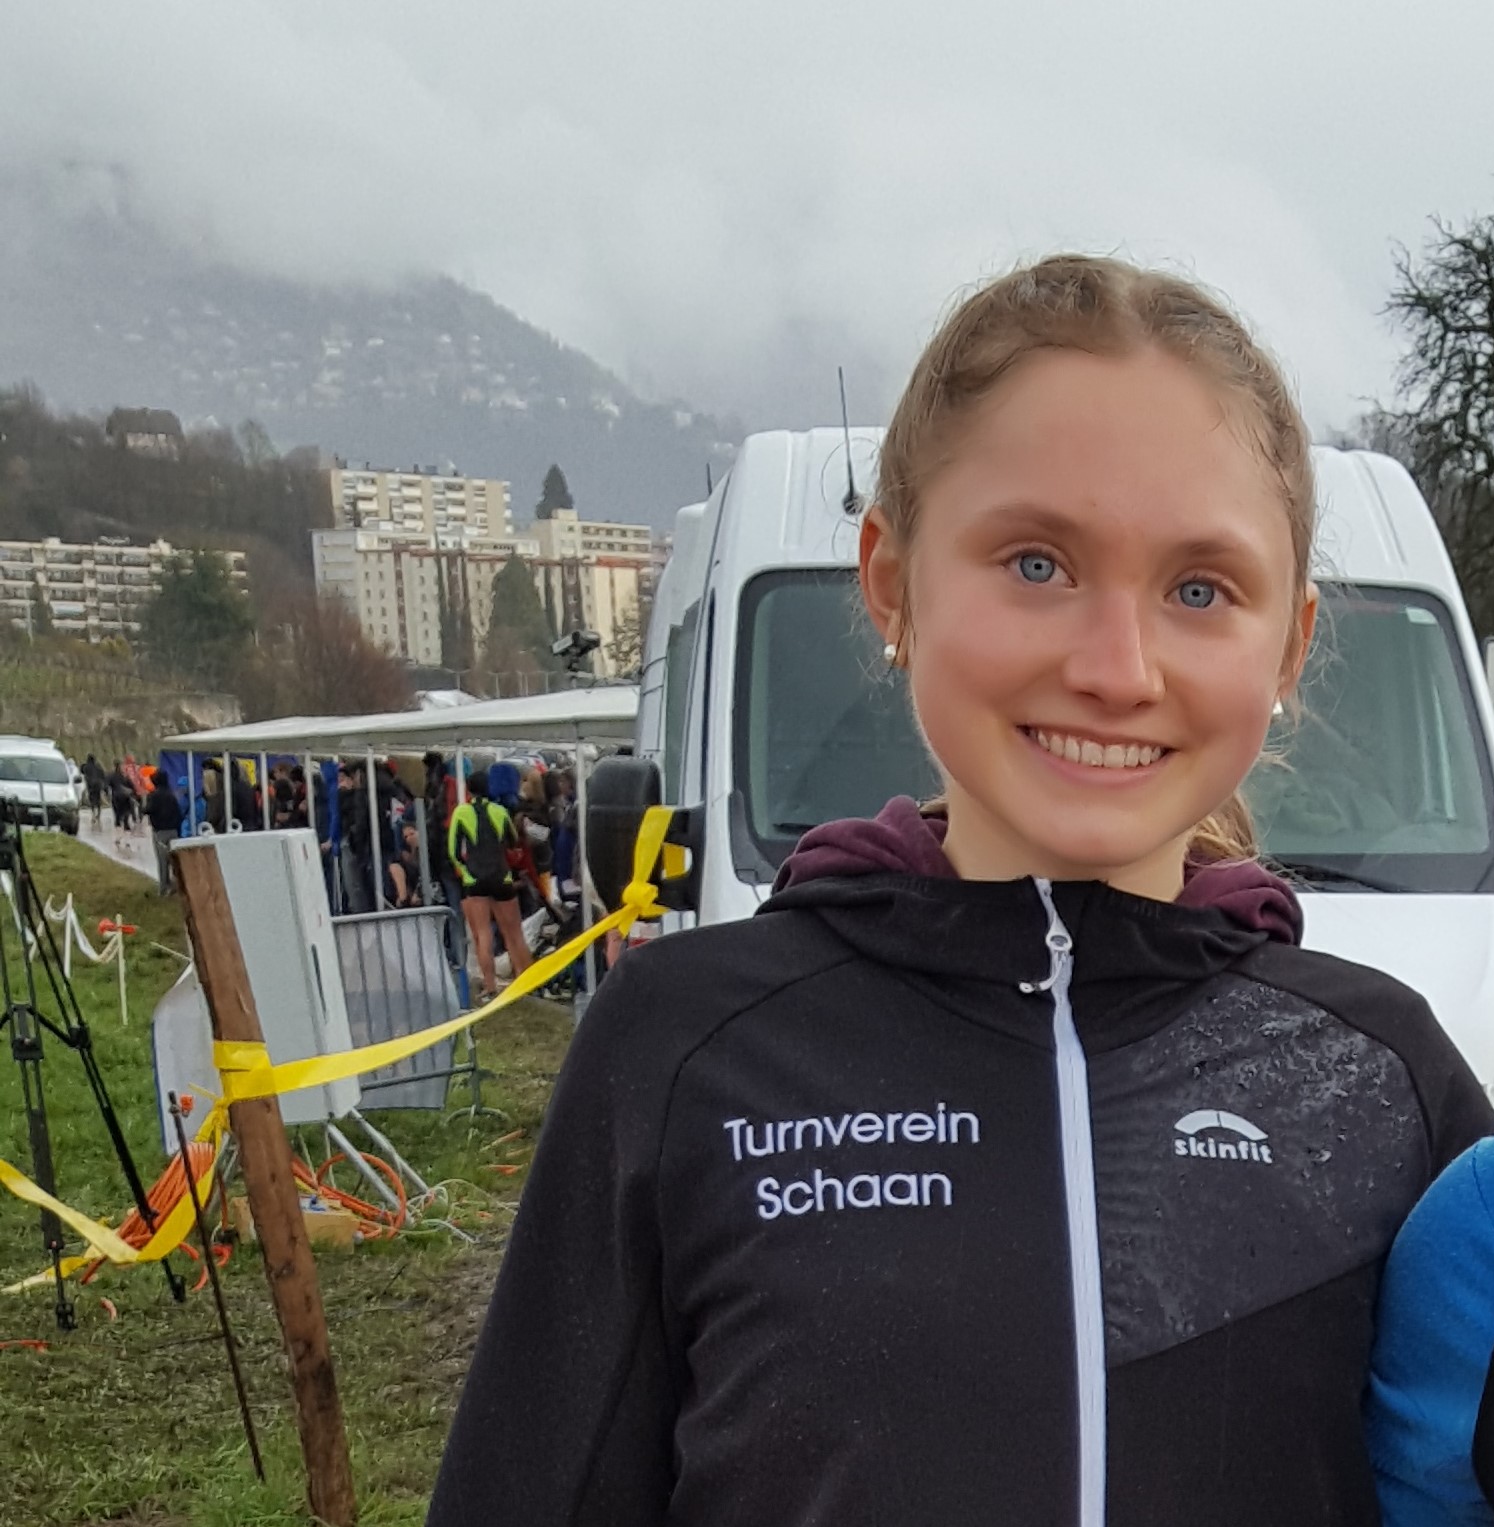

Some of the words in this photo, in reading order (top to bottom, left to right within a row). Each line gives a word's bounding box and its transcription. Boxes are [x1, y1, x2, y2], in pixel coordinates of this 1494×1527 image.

[723, 1102, 980, 1161] Turnverein
[1174, 1137, 1273, 1164] skinfit
[756, 1168, 952, 1220] Schaan
